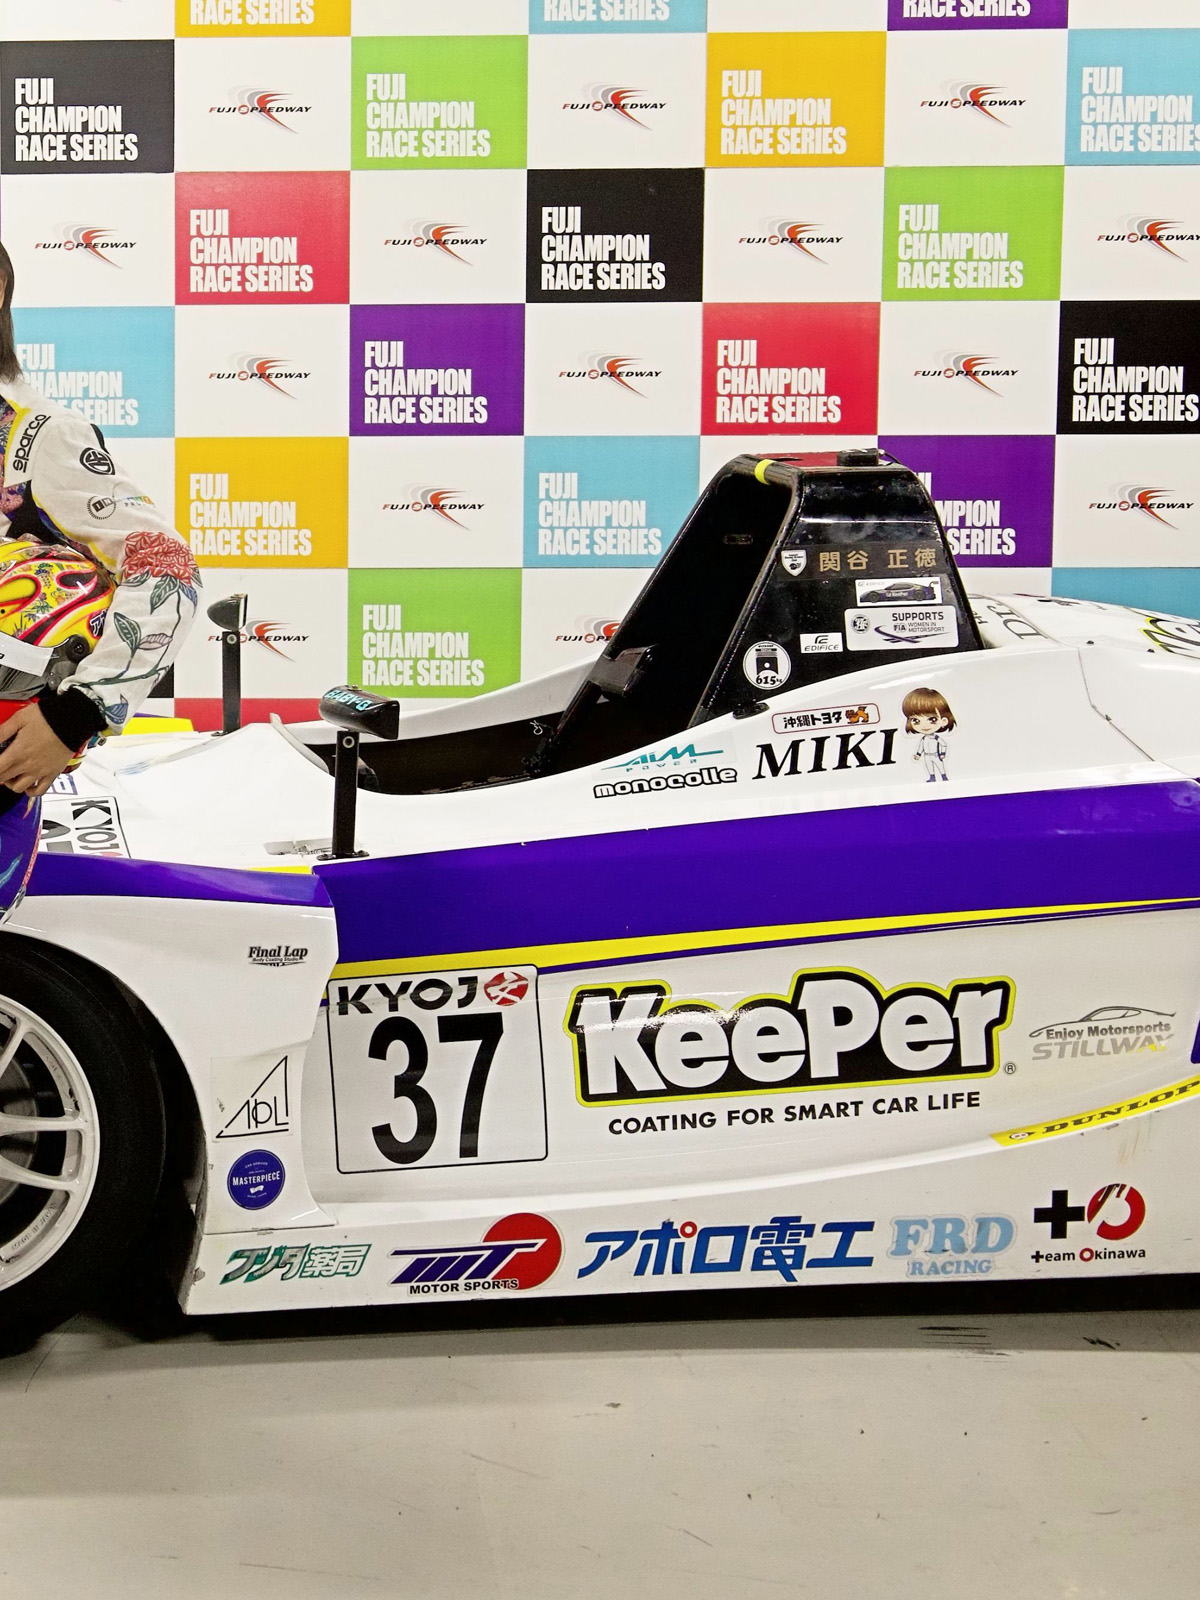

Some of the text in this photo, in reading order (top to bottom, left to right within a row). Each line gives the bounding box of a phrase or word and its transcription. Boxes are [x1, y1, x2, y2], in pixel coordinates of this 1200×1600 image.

[15, 78, 53, 105] FUJI
[721, 70, 760, 98] FUJI
[15, 105, 121, 133] CHAMPION
[721, 98, 830, 127] CHAMPION
[16, 133, 138, 161] RACE SERIES
[722, 127, 847, 155] RACE SERIES
[541, 207, 579, 234] FUJI
[897, 205, 936, 232] FUJI
[541, 234, 648, 262] CHAMPION
[897, 232, 1006, 260] CHAMPION
[542, 262, 665, 290] RACE SERIES
[898, 260, 1023, 288] RACE SERIES
[1074, 338, 1114, 365] FUJI
[1073, 367, 1183, 394] CHAMPION
[1072, 394, 1199, 422] RACE SERIES
[13, 414, 49, 472] sparco
[362, 605, 400, 631] FUJI
[891, 611, 944, 621] SUPPORTS
[362, 632, 468, 659] CHAMPION
[804, 644, 839, 652] EDIFICE
[363, 659, 484, 686] RACE SERIES
[325, 690, 373, 711] BABY-G
[752, 728, 899, 780] MIKI
[248, 945, 308, 960] Final Lap
[577, 979, 1003, 1095] KeePer
[1046, 1021, 1171, 1040] Enjoy Motorsports
[1032, 1034, 1174, 1060] STILLWAY
[368, 1012, 504, 1164] 37
[609, 1091, 981, 1135] COATING FOR SMART CAR LIFE
[1042, 1080, 1200, 1134] DUNLOP
[232, 1170, 280, 1186] MASTERPIECE
[577, 1215, 875, 1282] アポロ電工
[890, 1216, 1014, 1256] FRD
[910, 1258, 993, 1276] RACING
[1079, 1247, 1146, 1263] Okinawa
[409, 1279, 518, 1294] MOTOR SPORTS
